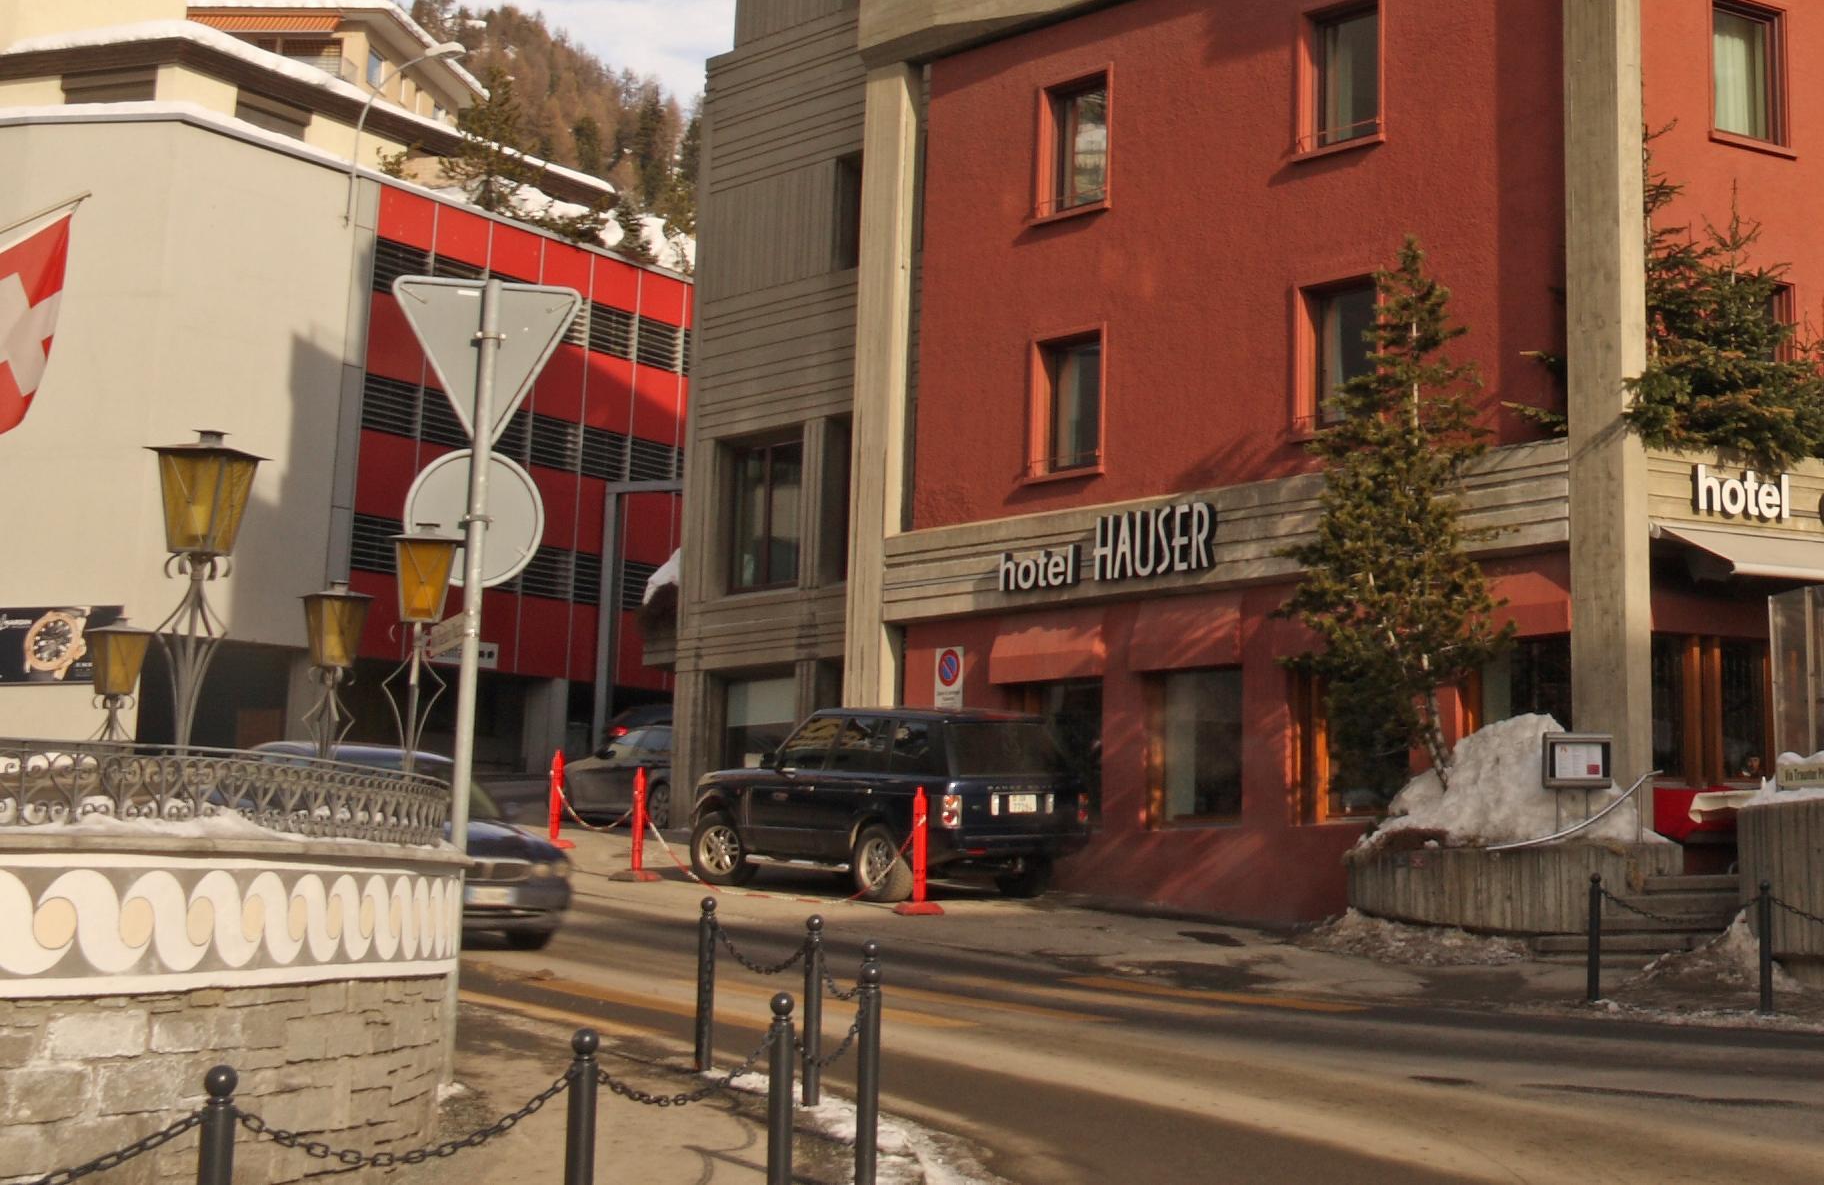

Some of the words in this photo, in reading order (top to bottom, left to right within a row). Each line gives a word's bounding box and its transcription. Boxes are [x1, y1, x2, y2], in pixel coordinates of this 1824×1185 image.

[1697, 464, 1789, 519] hotel
[1000, 544, 1075, 592] hotel
[1093, 502, 1210, 581] HAUSER
